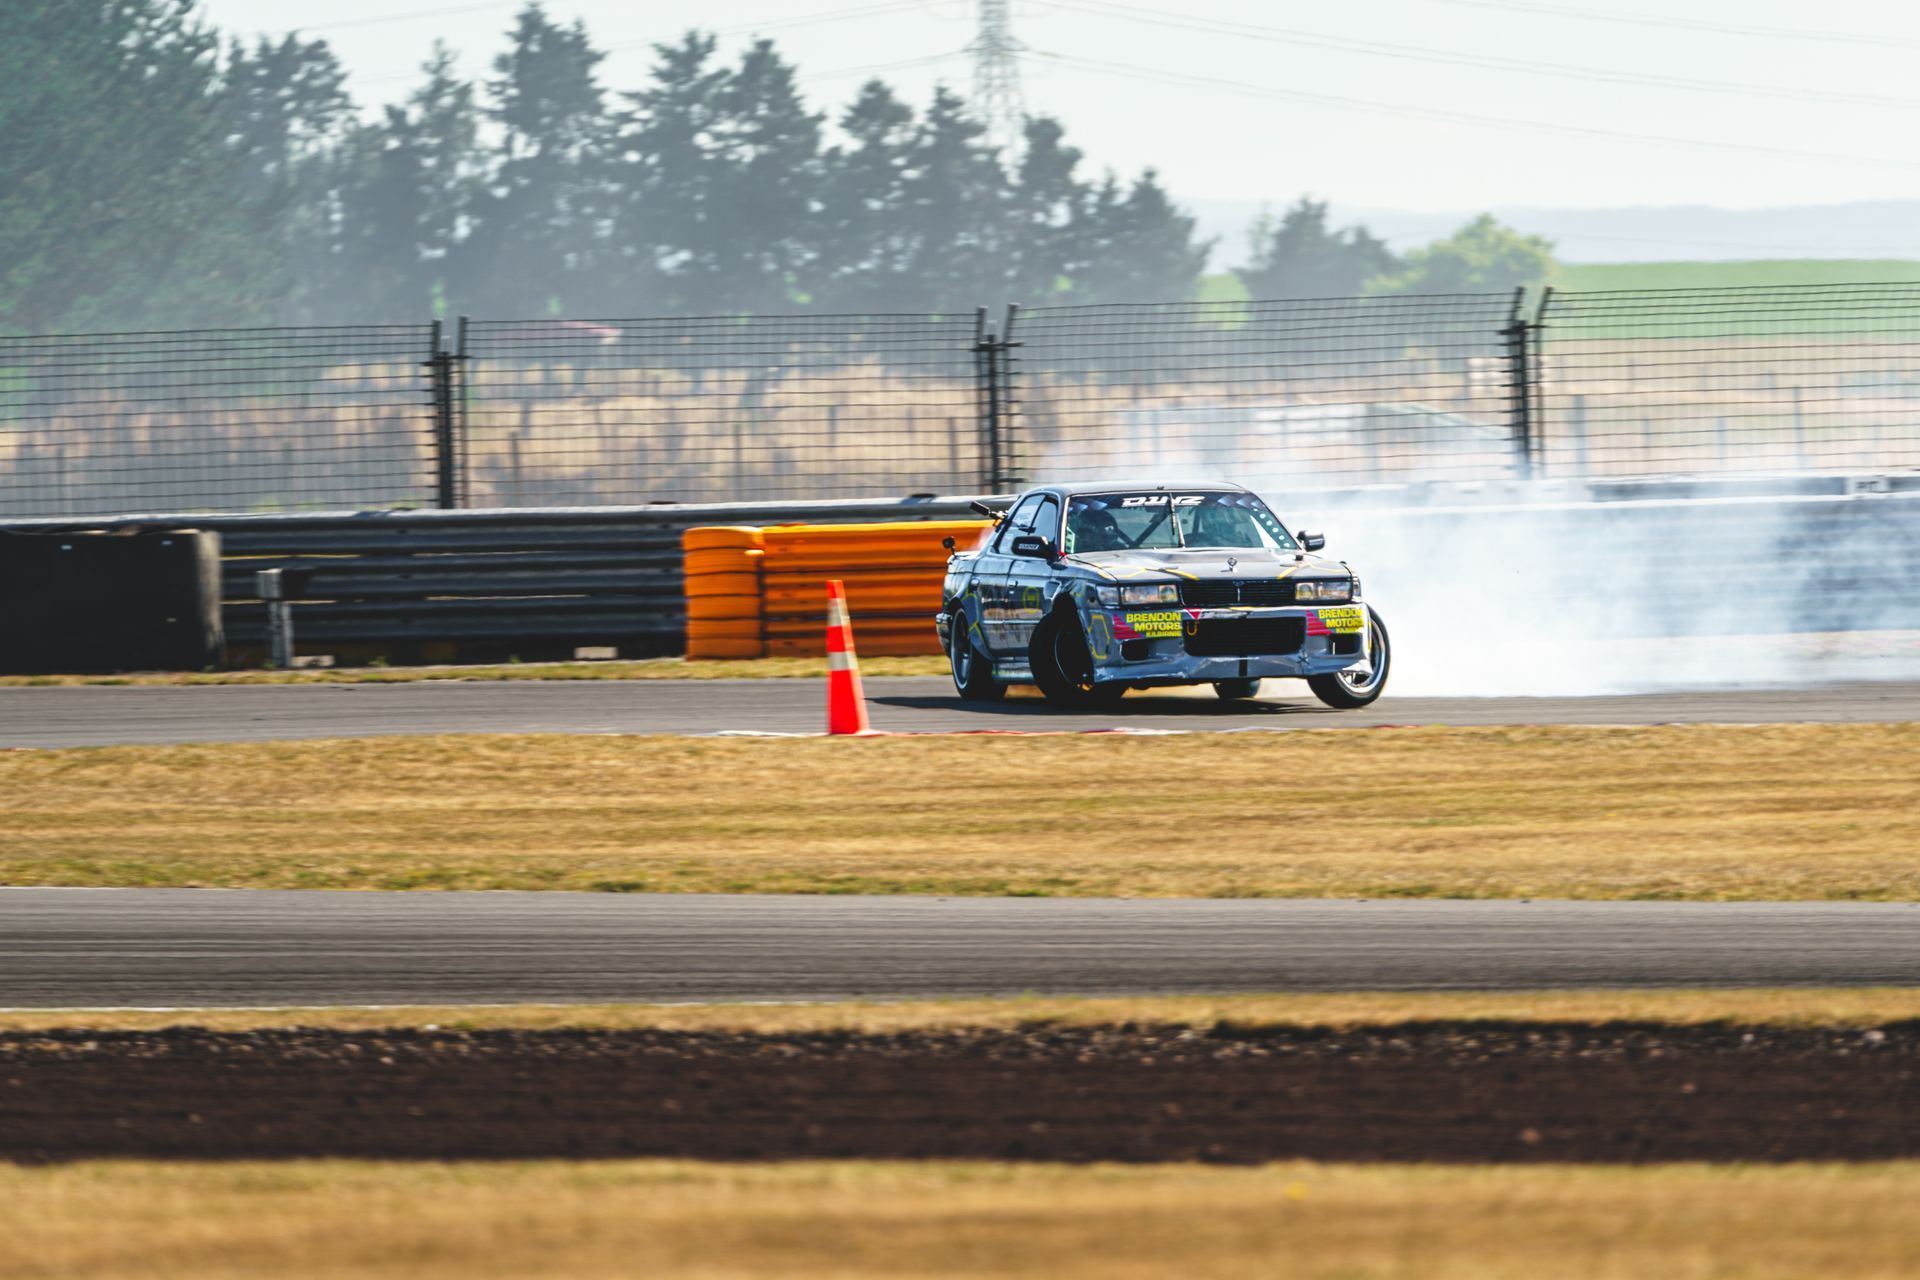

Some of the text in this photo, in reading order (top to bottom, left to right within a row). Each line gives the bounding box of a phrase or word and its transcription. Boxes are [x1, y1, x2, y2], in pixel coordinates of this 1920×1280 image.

[1126, 612, 1182, 623] BRENDON
[1134, 622, 1182, 631] MOTORS
[1325, 618, 1364, 627] MOTORS
